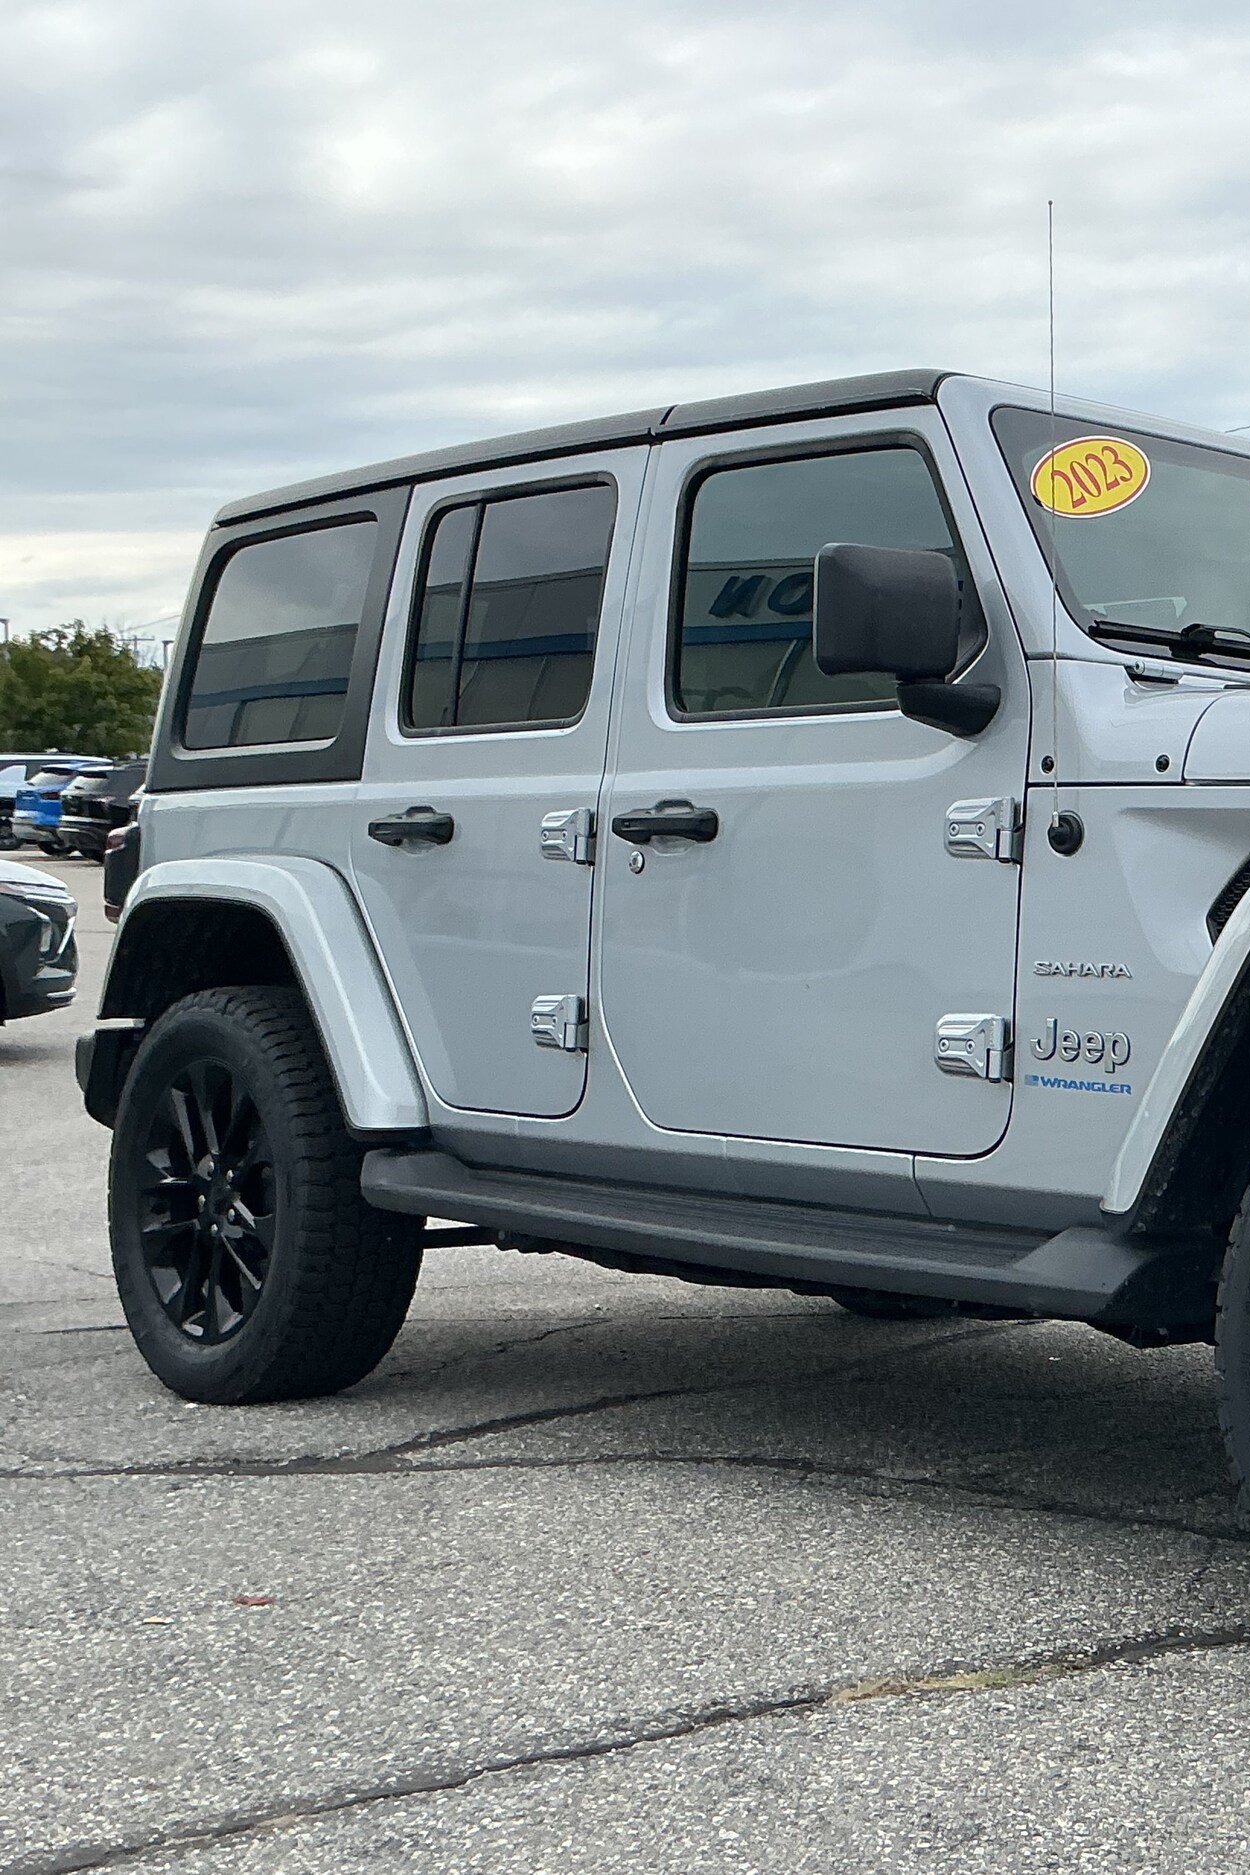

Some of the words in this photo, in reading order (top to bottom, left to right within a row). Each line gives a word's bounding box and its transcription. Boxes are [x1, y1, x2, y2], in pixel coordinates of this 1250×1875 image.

[1052, 447, 1132, 508] 2023
[1034, 961, 1133, 978] SAHARA
[1030, 1017, 1131, 1073] Jeep
[1041, 1077, 1132, 1095] WRANGLER
